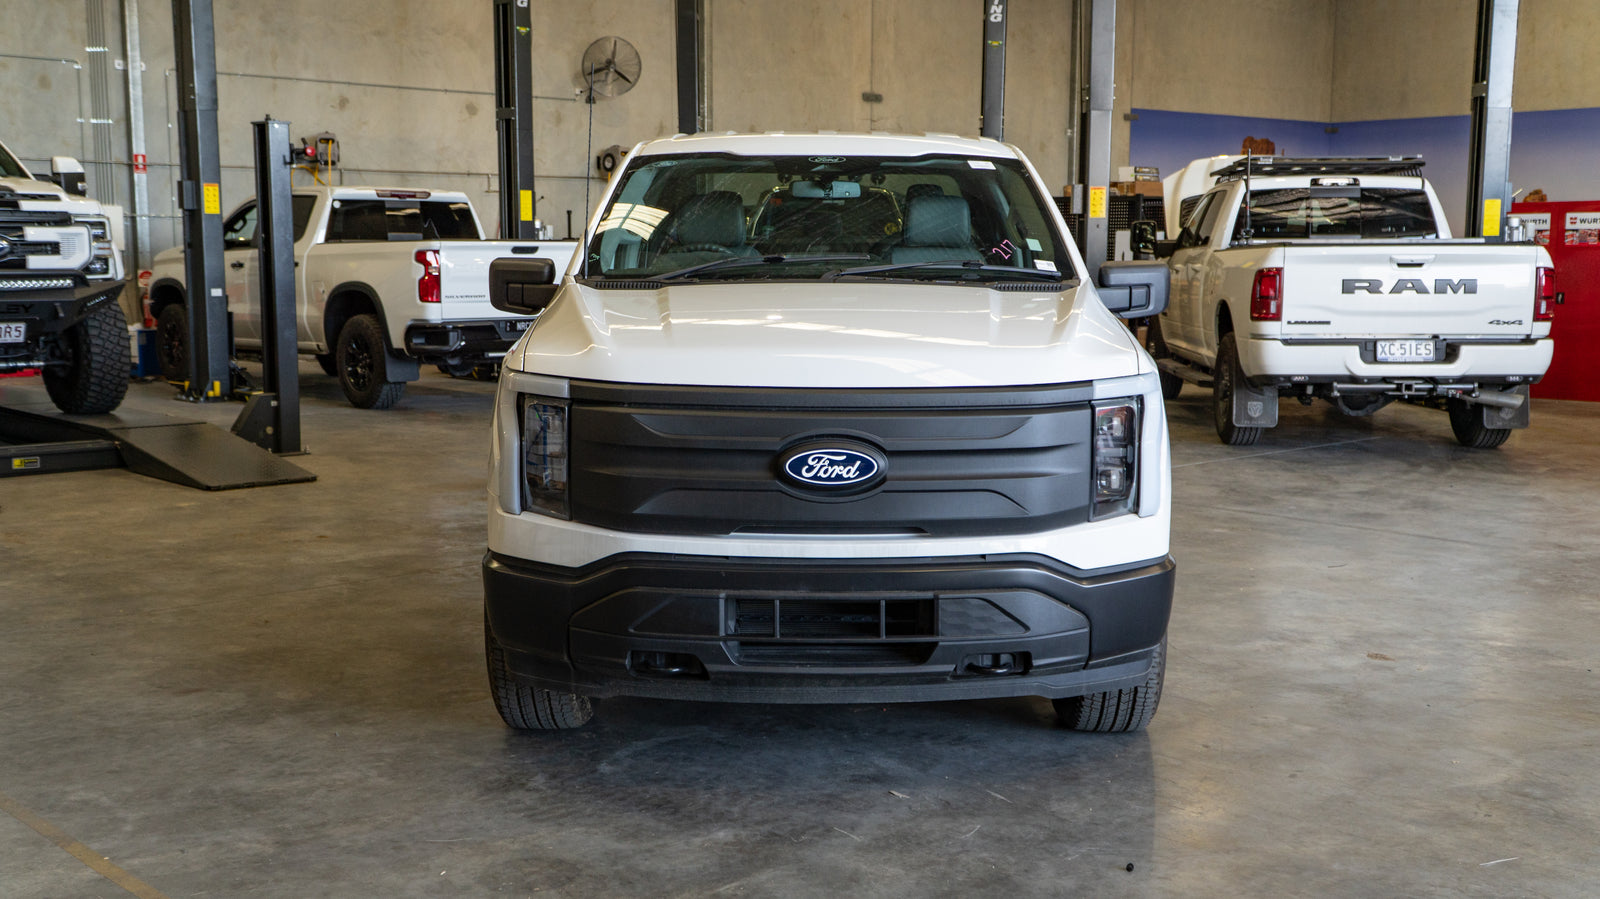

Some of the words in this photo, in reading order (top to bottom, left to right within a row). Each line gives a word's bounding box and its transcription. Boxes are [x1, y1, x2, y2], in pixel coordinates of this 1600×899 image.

[992, 239, 1017, 260] 217
[1341, 278, 1478, 294] RAM
[801, 454, 861, 478] Ford
